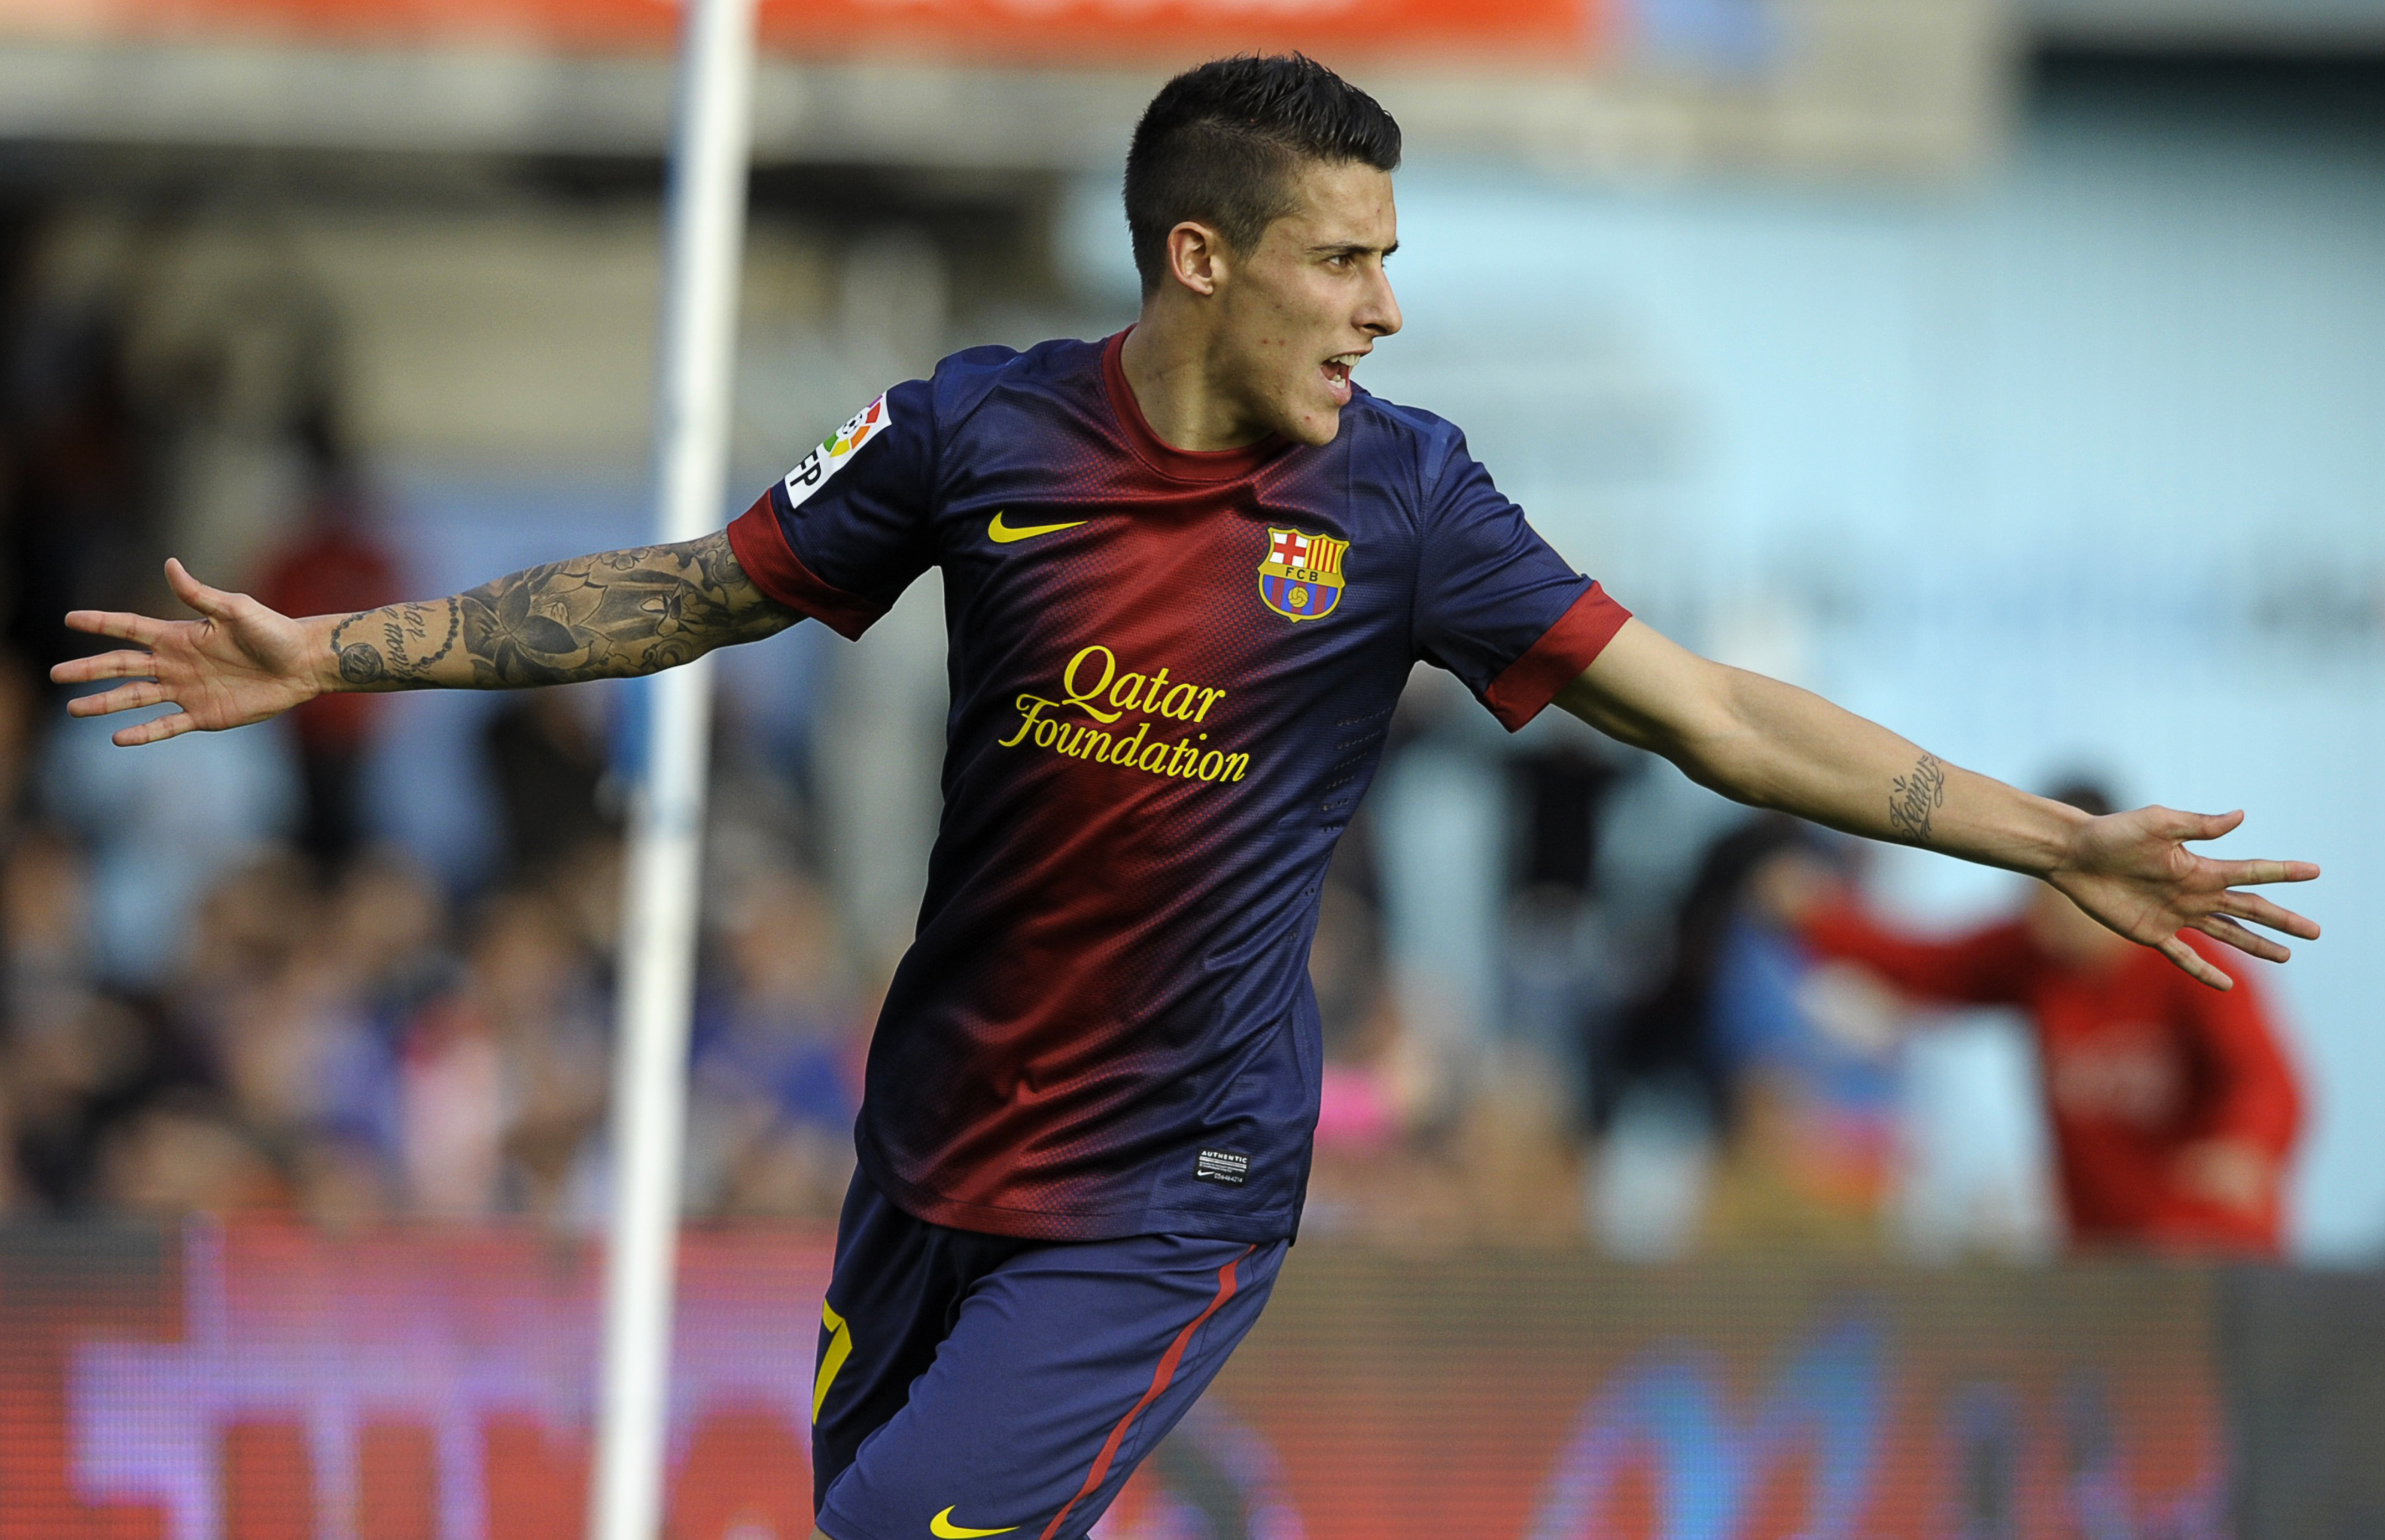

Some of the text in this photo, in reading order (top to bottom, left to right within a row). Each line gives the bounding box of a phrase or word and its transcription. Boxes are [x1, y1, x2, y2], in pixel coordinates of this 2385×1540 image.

[1285, 567, 1318, 582] FCB
[1062, 645, 1225, 723] Qatar
[998, 693, 1249, 782] Foundation
[1201, 1151, 1247, 1163] AUTHENTIC
